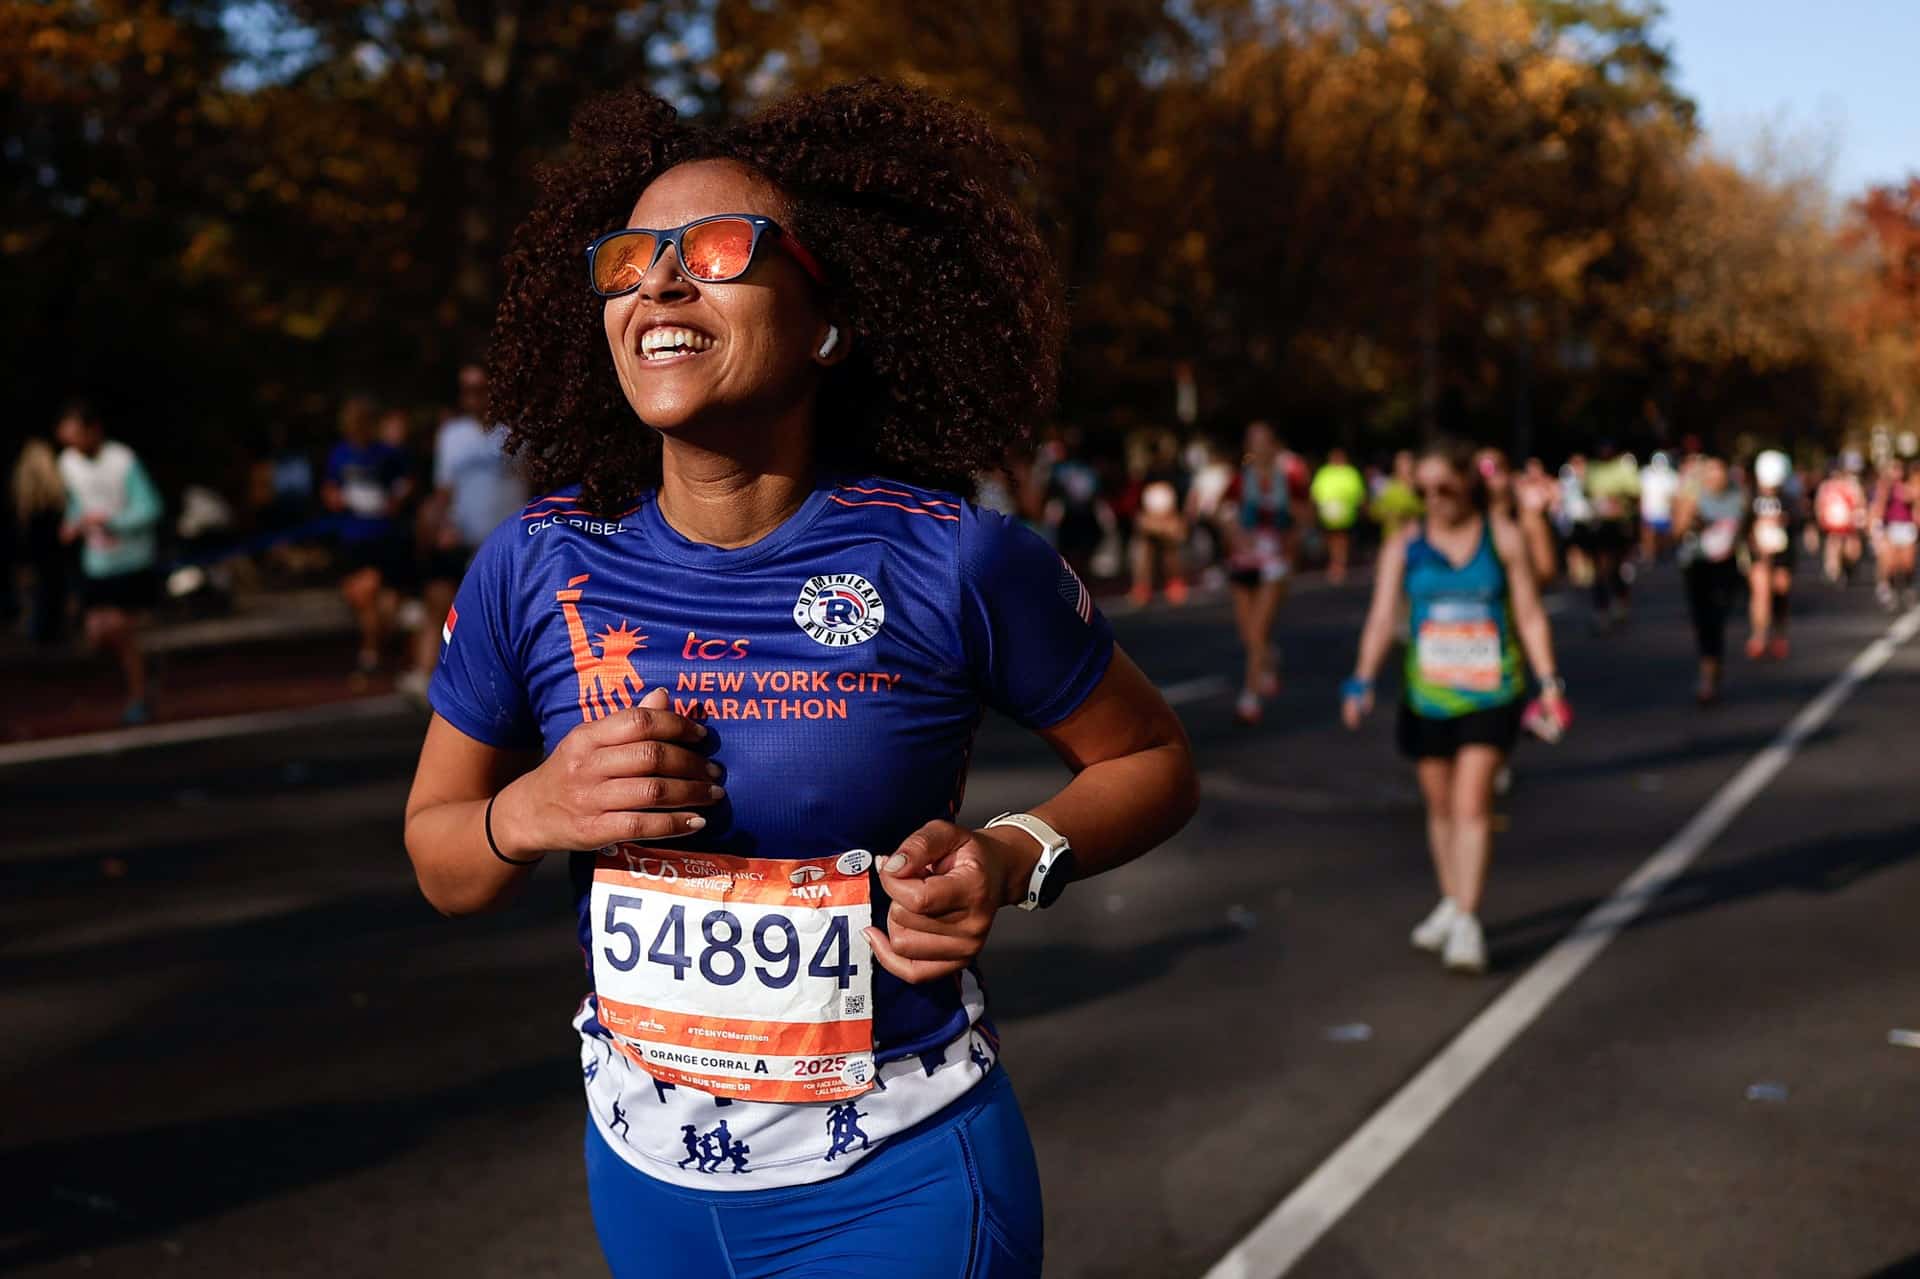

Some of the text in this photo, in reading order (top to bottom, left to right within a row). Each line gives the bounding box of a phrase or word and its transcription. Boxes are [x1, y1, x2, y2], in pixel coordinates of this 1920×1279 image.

[799, 575, 882, 609] DOMINICAN
[803, 618, 880, 646] RUNNERS
[682, 631, 750, 660] tcs
[676, 670, 901, 693] NEW YORK CITY
[674, 698, 848, 720] MARATHON
[603, 893, 858, 990] 54894
[650, 1049, 699, 1066] ORANGE
[700, 1057, 751, 1071] CORRAL
[754, 1059, 769, 1074] A
[793, 1056, 847, 1076] 2025
